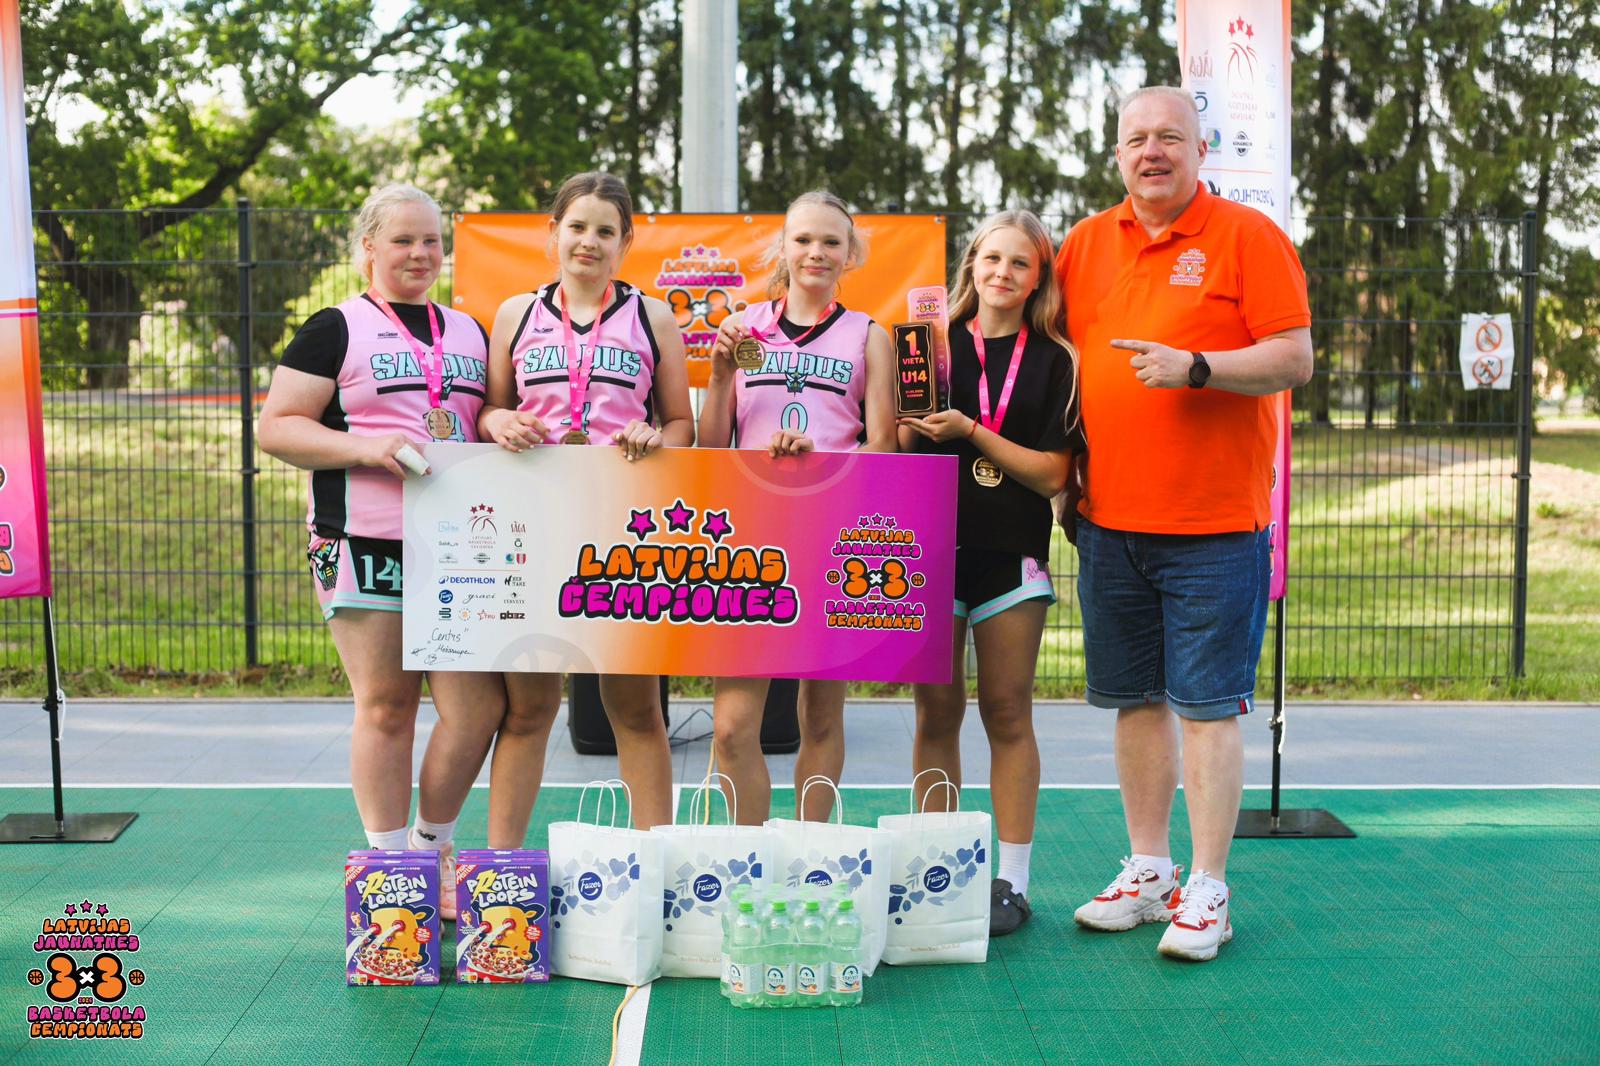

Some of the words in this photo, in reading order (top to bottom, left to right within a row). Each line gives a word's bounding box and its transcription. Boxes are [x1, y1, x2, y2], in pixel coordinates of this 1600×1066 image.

[902, 357, 925, 365] VIETA
[902, 370, 927, 384] U14
[840, 529, 915, 544] LATVIJAS
[832, 542, 921, 558] JAUNATNES
[578, 543, 787, 585] LATVIJAS
[360, 555, 403, 590] 14
[450, 576, 495, 584] DECATHLON
[558, 576, 799, 624] ČEMPIONES
[825, 601, 925, 616] BASKETBOLA
[355, 870, 428, 902] PROTEIN
[466, 869, 538, 901] PROTEIN
[580, 876, 602, 890] Fazer
[695, 880, 720, 892] Fazer
[926, 872, 950, 885] Fazer
[368, 889, 425, 910] LOOPS
[478, 888, 535, 908] LOOPS
